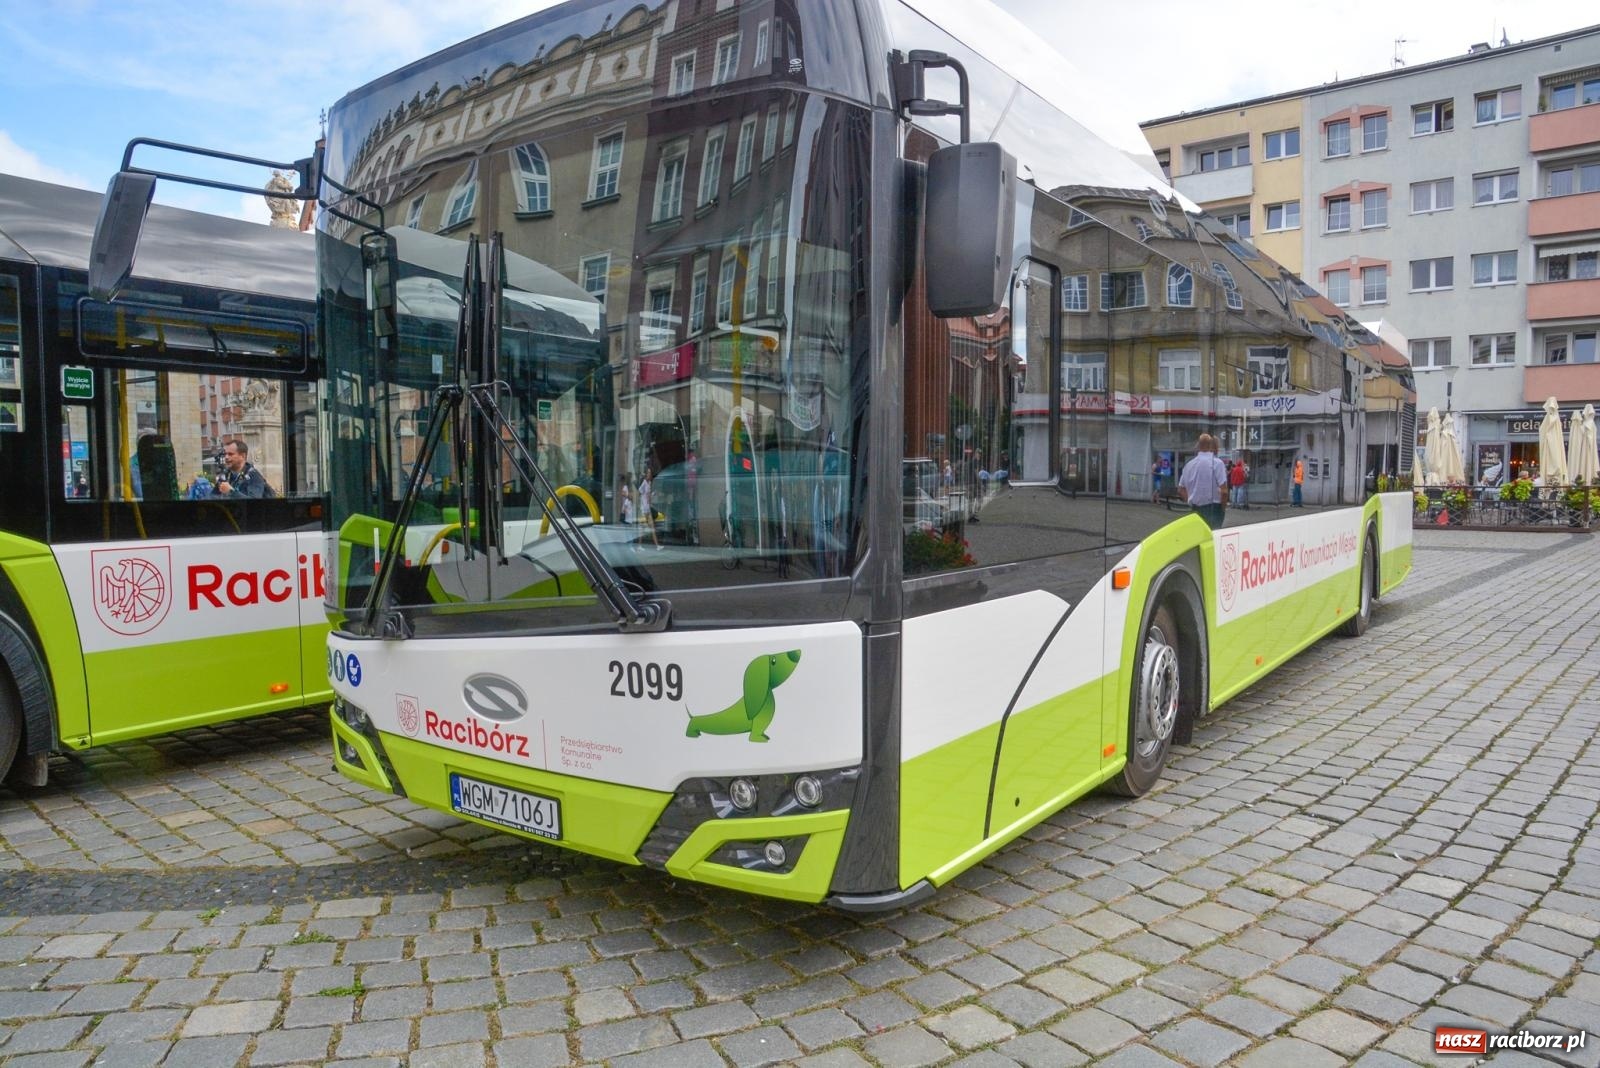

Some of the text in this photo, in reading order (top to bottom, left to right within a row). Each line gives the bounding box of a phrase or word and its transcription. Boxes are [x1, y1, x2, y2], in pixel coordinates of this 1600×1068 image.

[1240, 540, 1295, 591] Racibórz
[608, 660, 683, 702] 2099
[425, 710, 530, 758] Racibórz
[560, 735, 623, 754] Przedsiębiorstwo
[560, 747, 602, 761] Komunalne
[461, 780, 494, 813] WGM
[499, 790, 554, 829] 7106J
